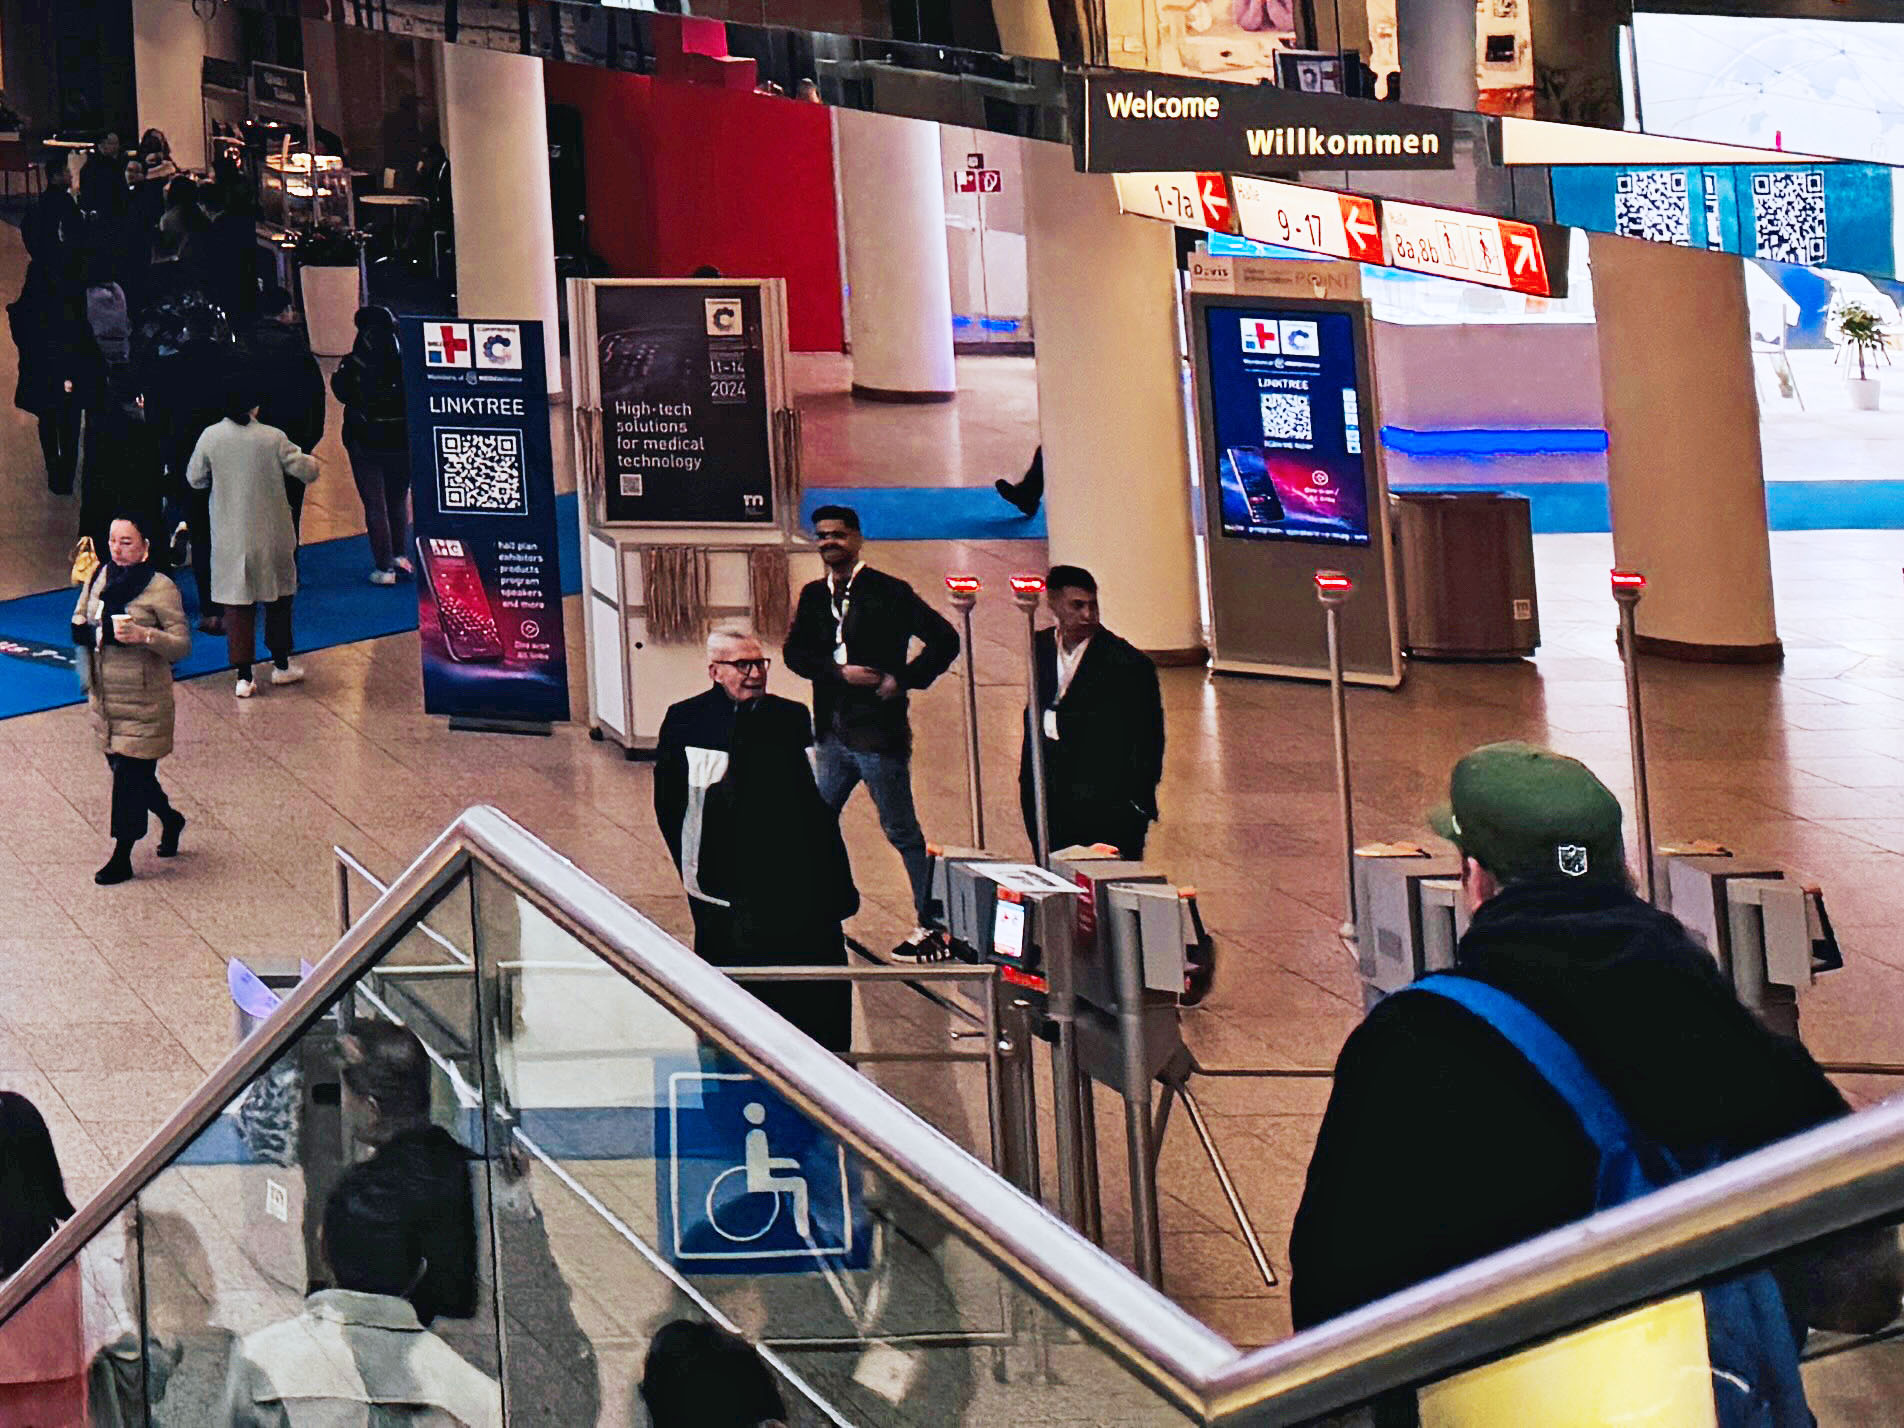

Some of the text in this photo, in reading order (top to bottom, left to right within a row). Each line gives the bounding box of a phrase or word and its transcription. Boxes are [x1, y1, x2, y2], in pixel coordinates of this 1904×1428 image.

[1106, 90, 1220, 119] Welcome
[1246, 128, 1440, 157] Willkommen
[710, 381, 746, 397] 2024
[429, 396, 526, 416] LINKTREE
[616, 418, 689, 433] solutions
[617, 435, 705, 452] for medical
[617, 454, 703, 472] technology
